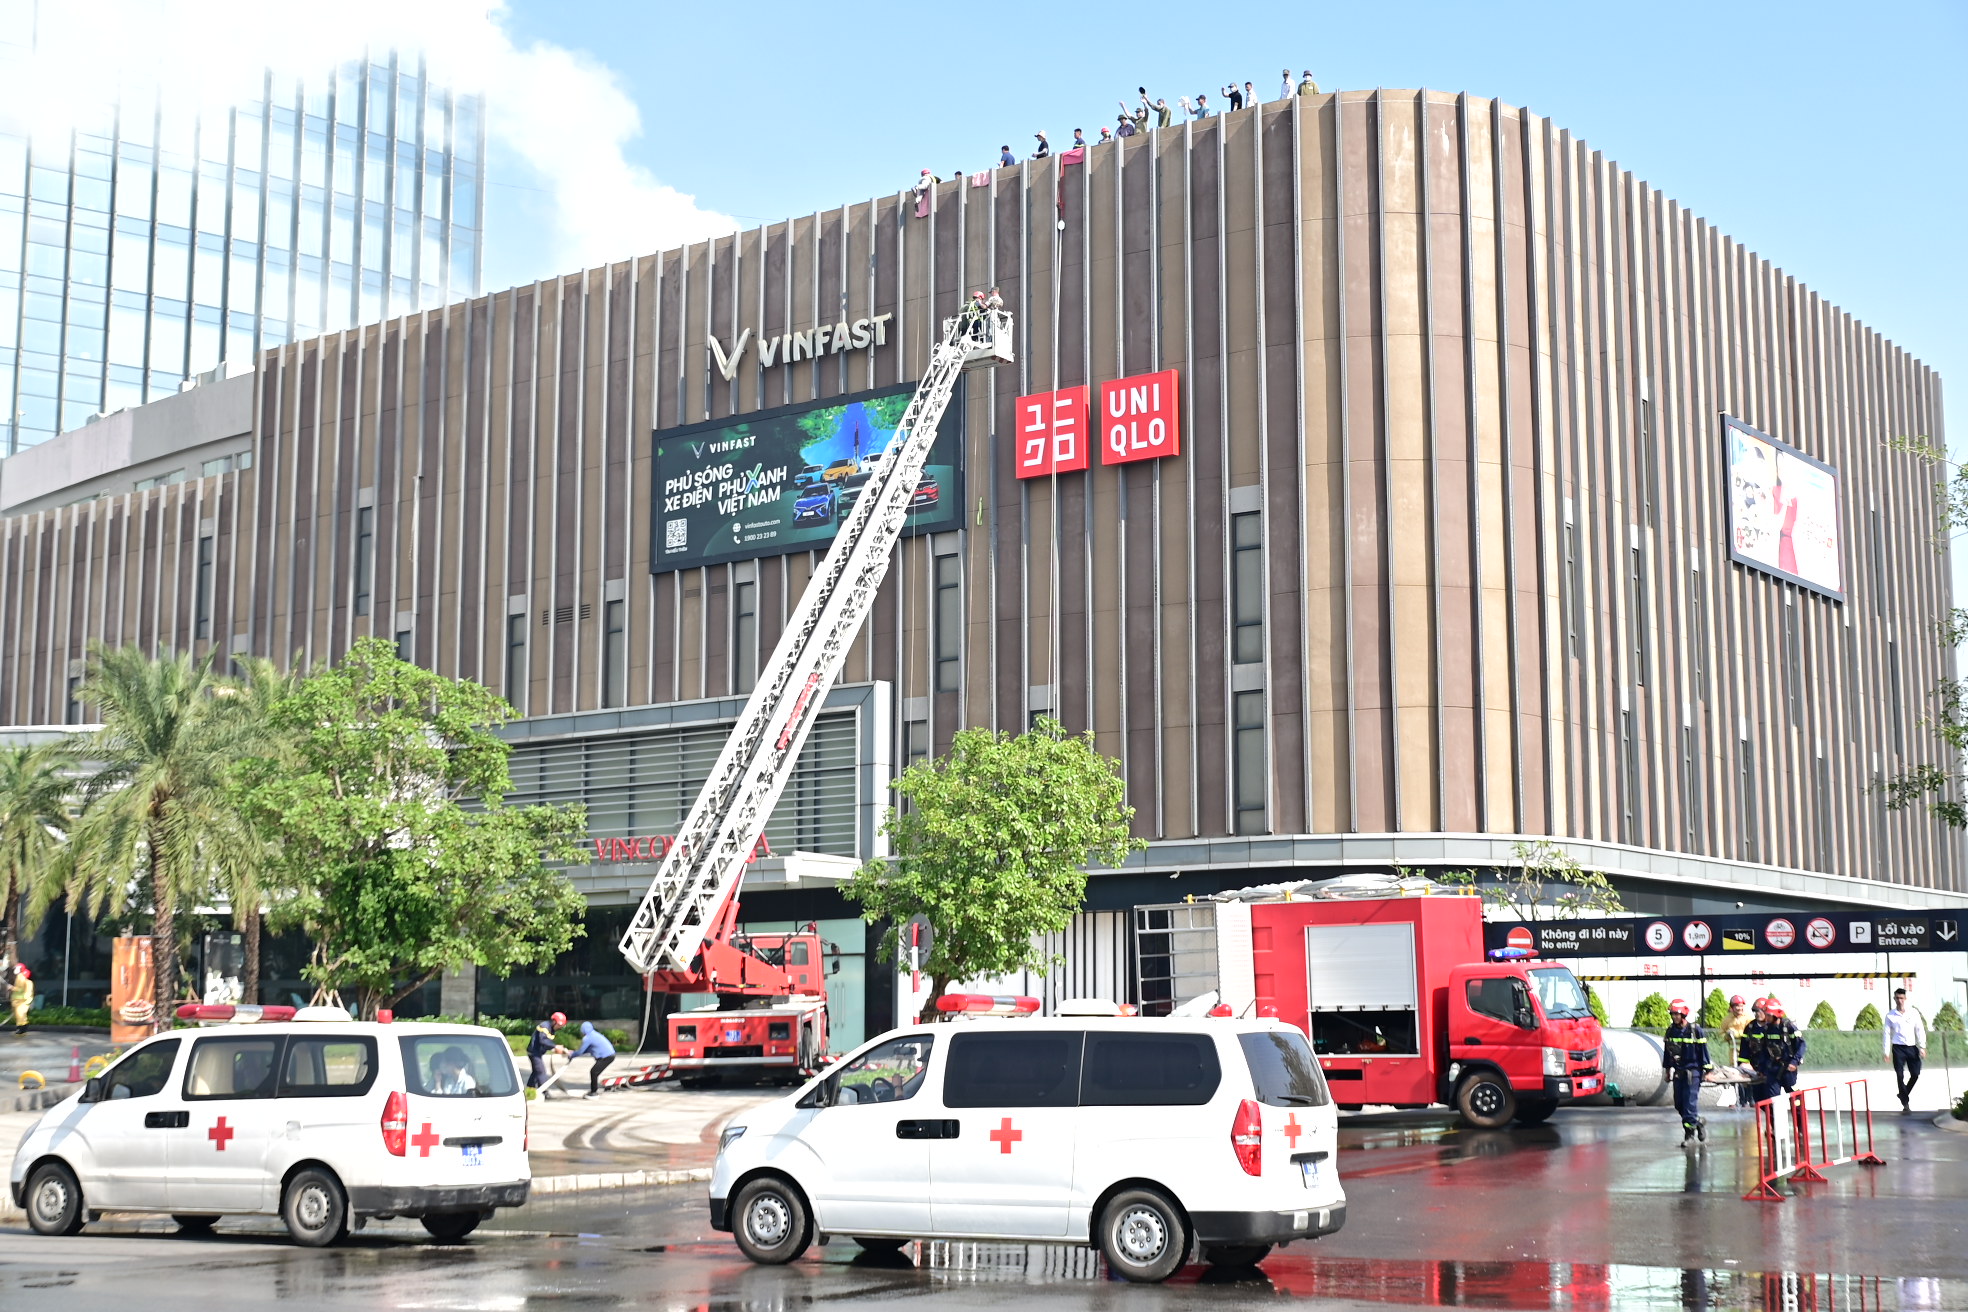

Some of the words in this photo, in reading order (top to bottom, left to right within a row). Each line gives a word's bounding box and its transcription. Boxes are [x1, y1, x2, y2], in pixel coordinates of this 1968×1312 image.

[757, 312, 892, 368] VINFAST
[1109, 383, 1160, 418] UNI
[1110, 417, 1166, 457] QLO
[709, 436, 757, 454] VINFAST
[665, 469, 693, 495] PHỦ
[694, 463, 734, 486] SÓNG
[664, 495, 681, 513] XE
[682, 485, 713, 509] ĐIỆN
[717, 494, 747, 517] VIỆT
[747, 485, 781, 508] NAM
[1541, 930, 1576, 940] Không
[1579, 928, 1590, 939] đi
[1608, 928, 1629, 940] này
[1654, 929, 1663, 940] 5
[1855, 926, 1865, 939] P
[1877, 922, 1898, 935] Lối
[1900, 923, 1926, 935] vào
[1734, 933, 1751, 941] 10%
[1878, 937, 1919, 946] Entrace
[1541, 941, 1555, 949] No
[1556, 941, 1580, 950] entry
